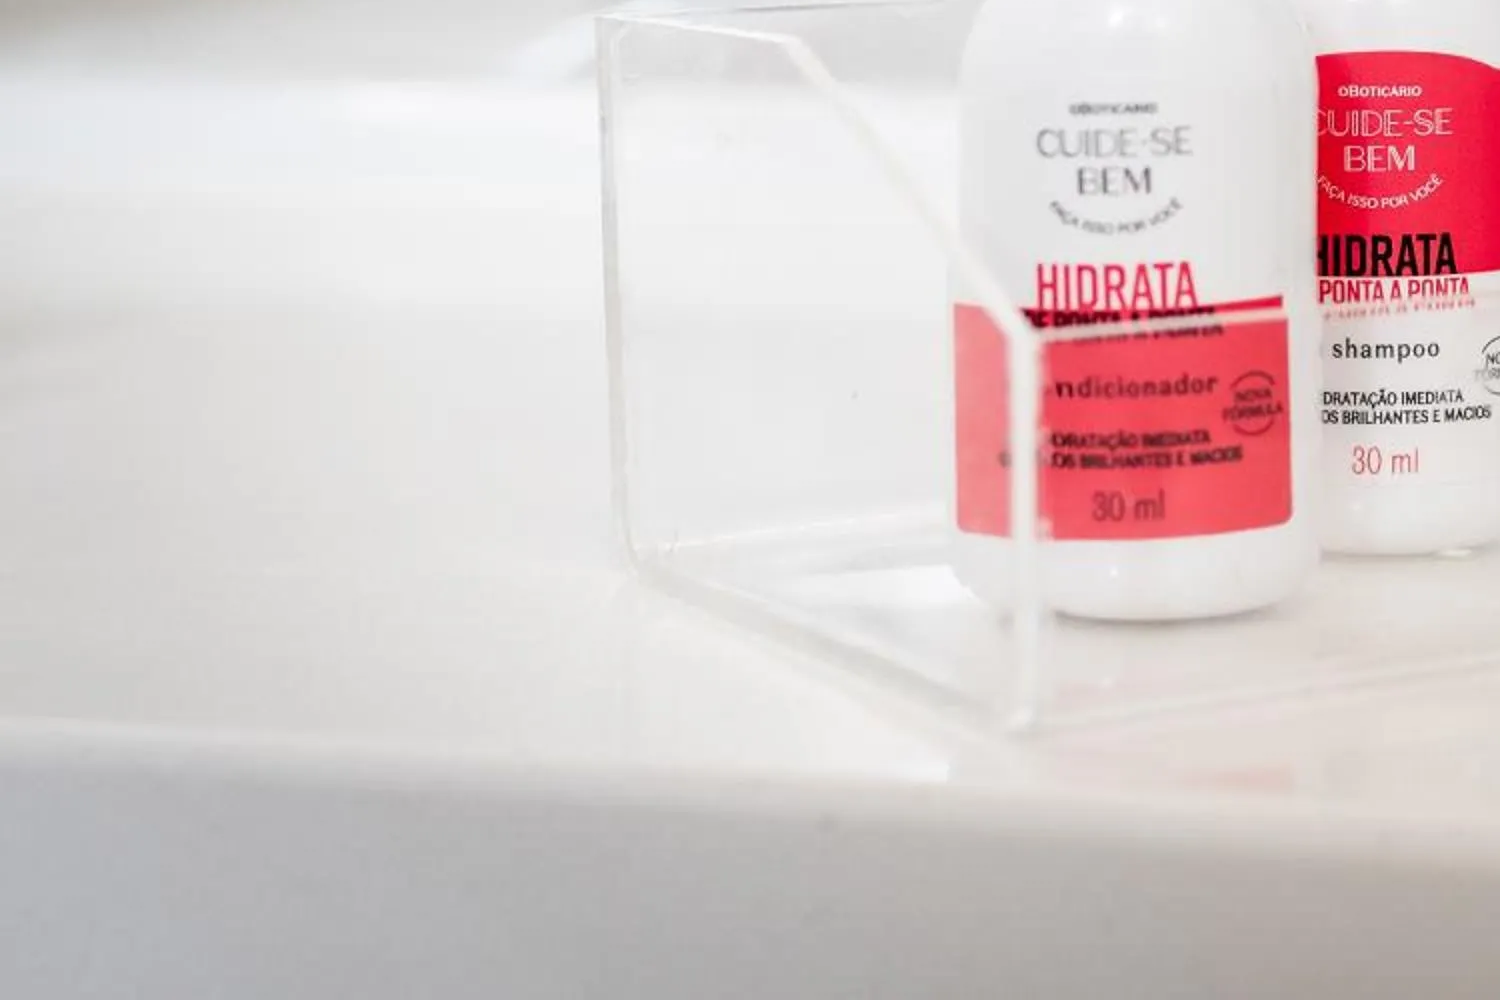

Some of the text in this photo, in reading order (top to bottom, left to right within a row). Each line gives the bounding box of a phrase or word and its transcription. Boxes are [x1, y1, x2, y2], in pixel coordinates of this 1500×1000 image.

[1036, 125, 1194, 159] CUIDE-SE
[1343, 145, 1415, 173] BEM
[1077, 166, 1152, 195] BEM
[1347, 193, 1380, 210] ISSO
[1381, 194, 1409, 209] POR
[1036, 261, 1198, 309] HIDRATA
[1319, 279, 1384, 305] PONTA
[1391, 279, 1402, 300] A
[1332, 336, 1441, 364] shampoo
[1054, 373, 1218, 399] ndicionador
[1233, 387, 1273, 402] NOVA
[1322, 388, 1465, 409] DRATAÇÃO IMEDIATA
[1342, 408, 1429, 425] BRILHANTES
[1433, 408, 1441, 423] E
[1444, 404, 1493, 422] MACIOS
[1352, 444, 1420, 476] 30 ml
[1091, 488, 1166, 523] 30 ml
